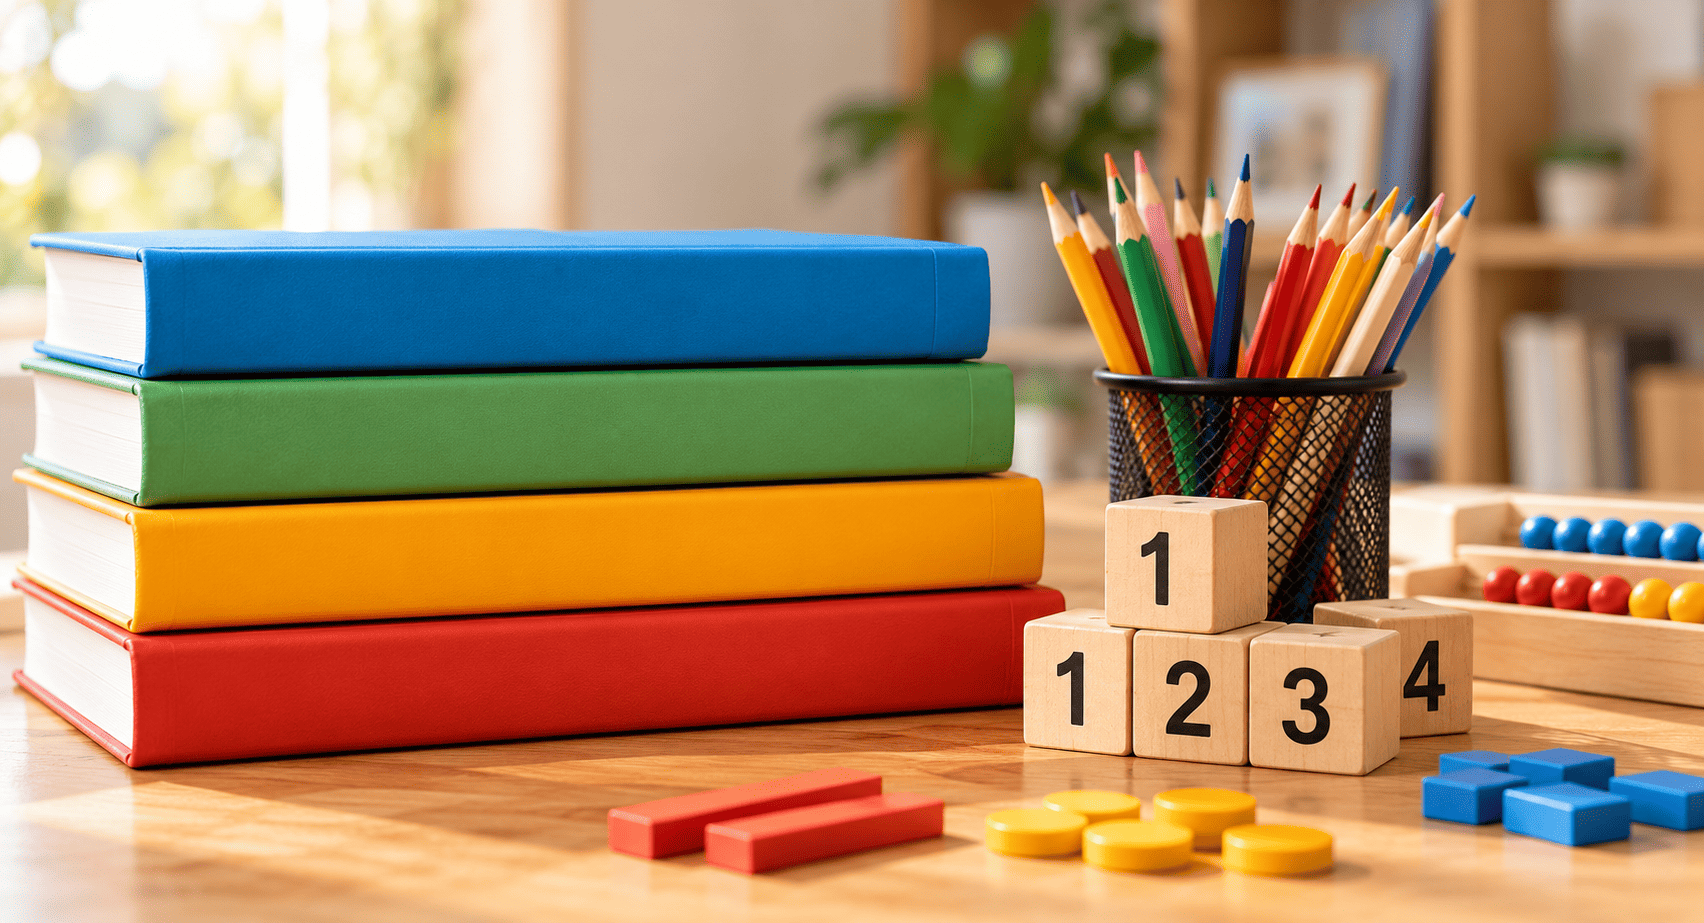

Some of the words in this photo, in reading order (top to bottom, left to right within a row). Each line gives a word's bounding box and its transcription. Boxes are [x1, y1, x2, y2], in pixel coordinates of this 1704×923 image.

[1141, 531, 1169, 606] 1
[1056, 651, 1084, 726] 1
[1166, 660, 1211, 738] 2
[1282, 667, 1331, 745] 3
[1403, 640, 1446, 712] 4
